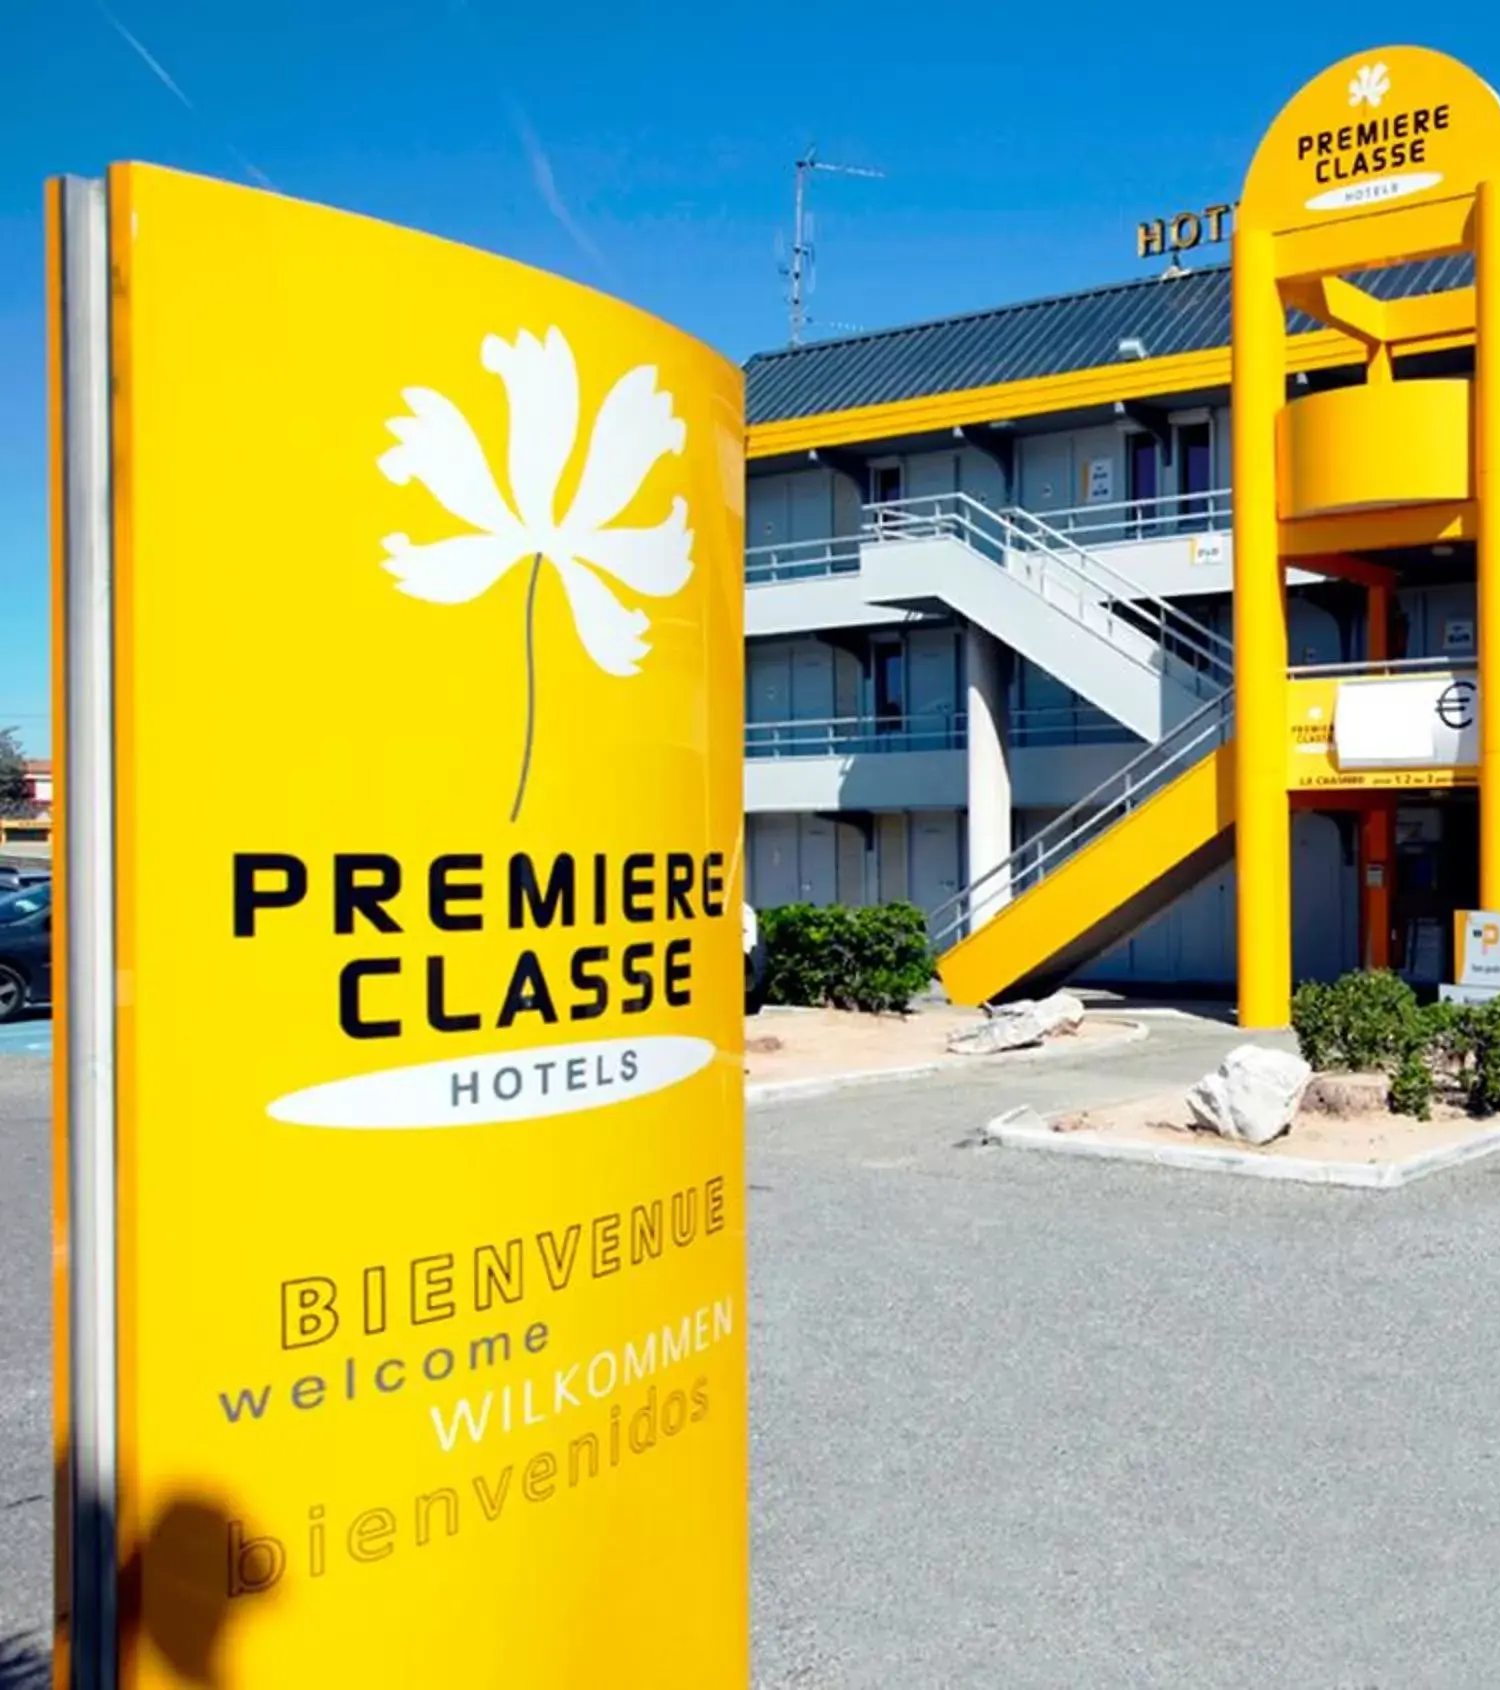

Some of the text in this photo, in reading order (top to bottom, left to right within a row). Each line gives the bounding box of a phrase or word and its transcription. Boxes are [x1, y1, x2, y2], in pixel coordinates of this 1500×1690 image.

[1298, 105, 1449, 160] PREMIERE
[1315, 139, 1425, 183] CLASSE
[1344, 183, 1399, 201] HOTELS
[233, 852, 725, 937] PREMIERE
[339, 939, 693, 1039] CLASSE
[450, 1049, 639, 1107] HOTELS
[280, 1176, 726, 1350] BIENVENUE
[218, 1319, 551, 1423] welcome
[430, 1296, 733, 1452] WILKOMMEN
[226, 1374, 711, 1598] bienvenidos
